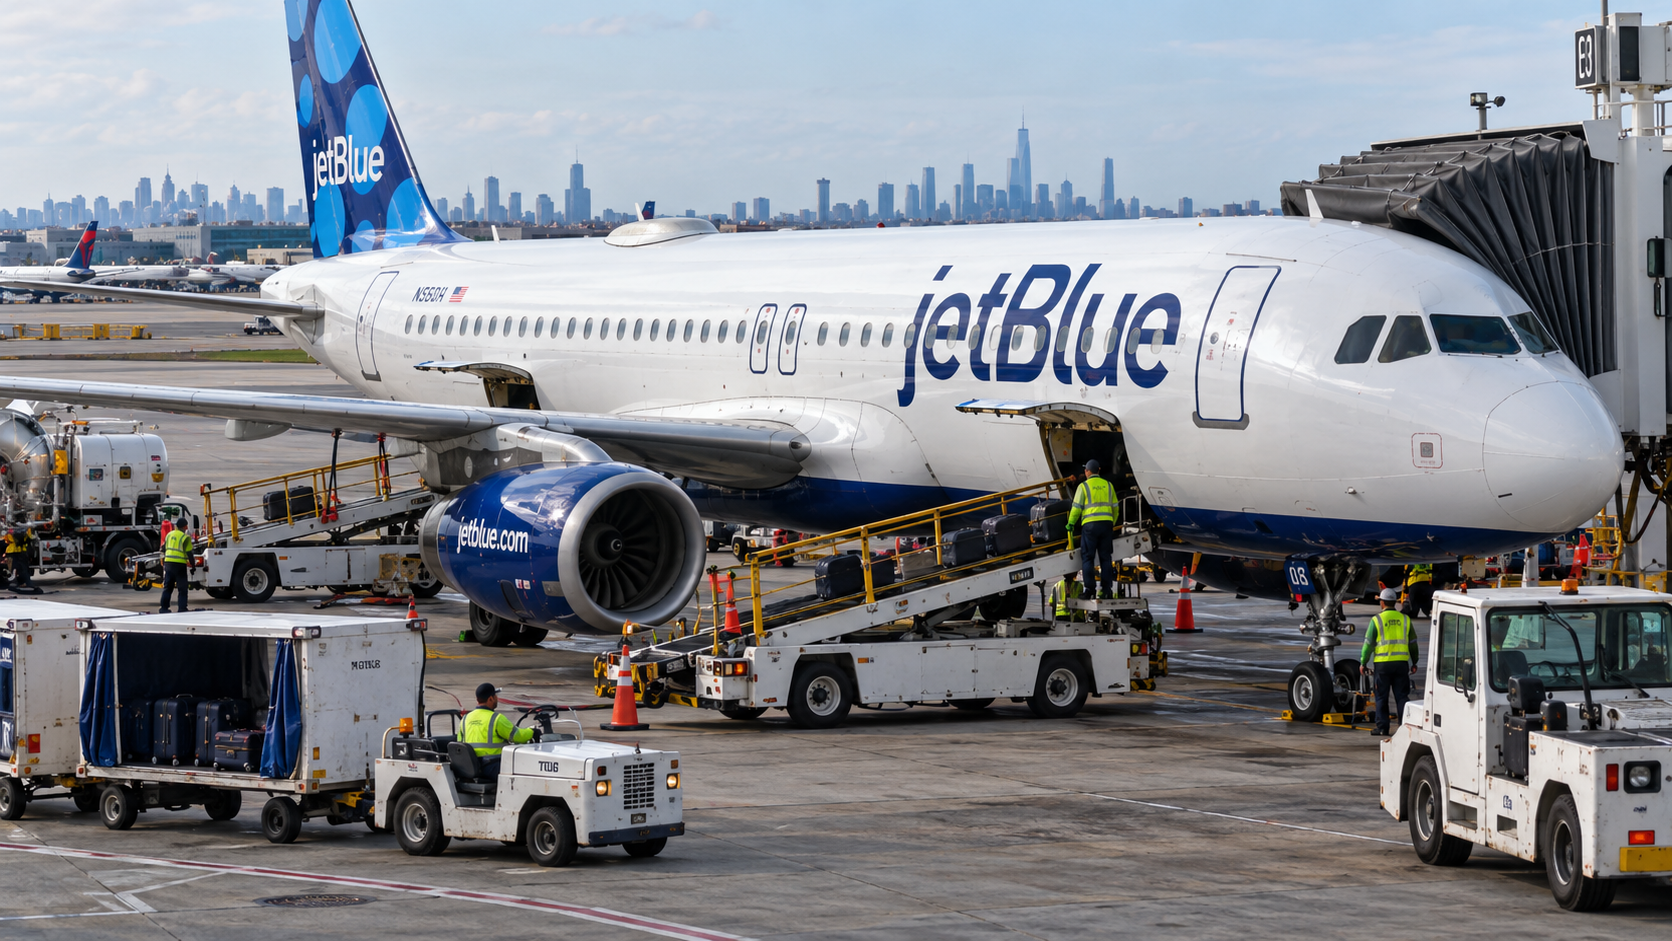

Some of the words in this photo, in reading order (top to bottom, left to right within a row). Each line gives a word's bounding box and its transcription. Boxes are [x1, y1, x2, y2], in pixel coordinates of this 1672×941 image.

[312, 135, 385, 201] jetBlue
[897, 263, 1182, 407] jetBlue
[456, 516, 529, 554] jetblue.com
[1289, 566, 1309, 586] 08
